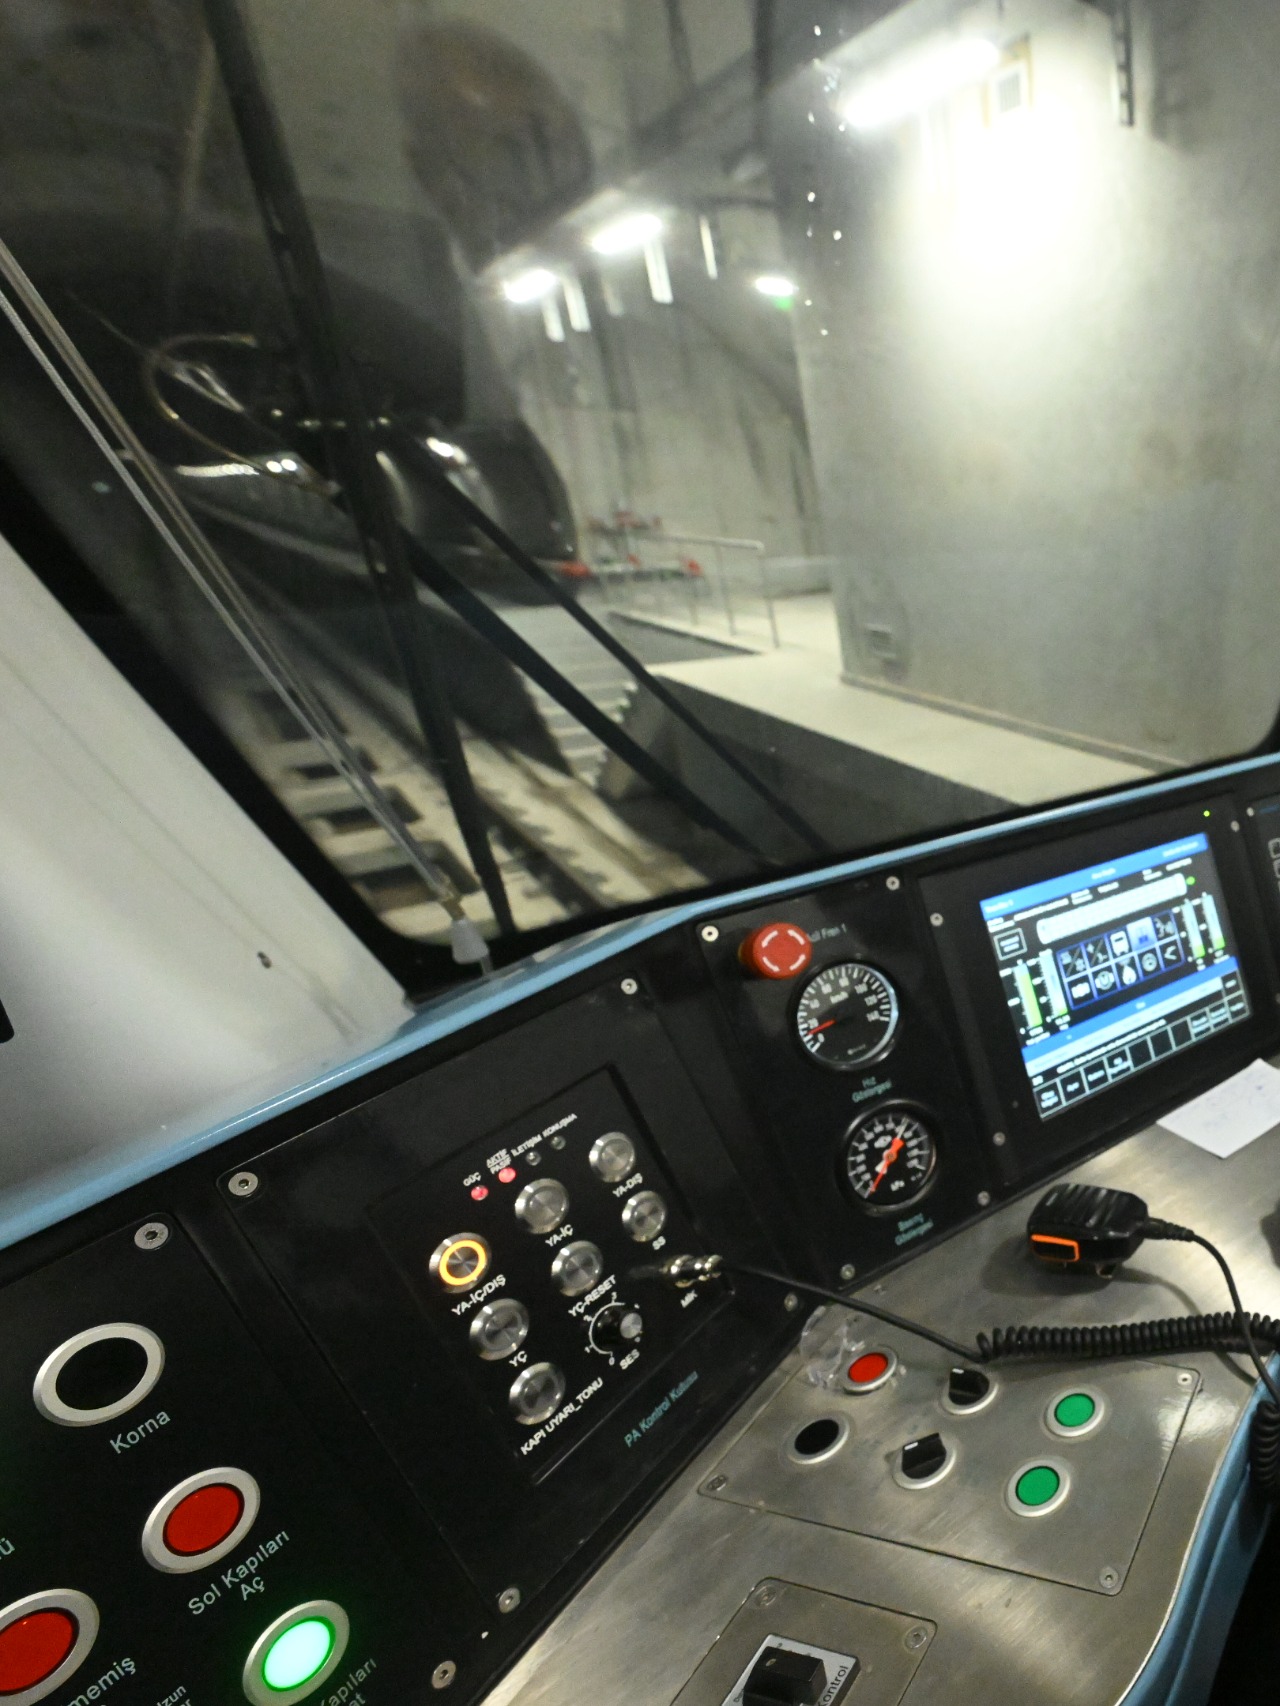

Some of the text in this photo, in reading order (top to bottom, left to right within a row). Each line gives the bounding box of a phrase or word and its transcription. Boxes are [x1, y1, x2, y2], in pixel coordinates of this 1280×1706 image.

[568, 1275, 617, 1318] YÇ-RESET
[508, 1350, 528, 1369] YÇ
[619, 1349, 640, 1370] SES
[109, 1410, 172, 1454] Korna
[624, 1428, 642, 1448] PA
[639, 1396, 671, 1432] Kontrol
[520, 1429, 546, 1456] KAPI
[188, 1530, 291, 1616] Sol Kapıları
[240, 1575, 266, 1601] Aç
[156, 1685, 187, 1706] zun
